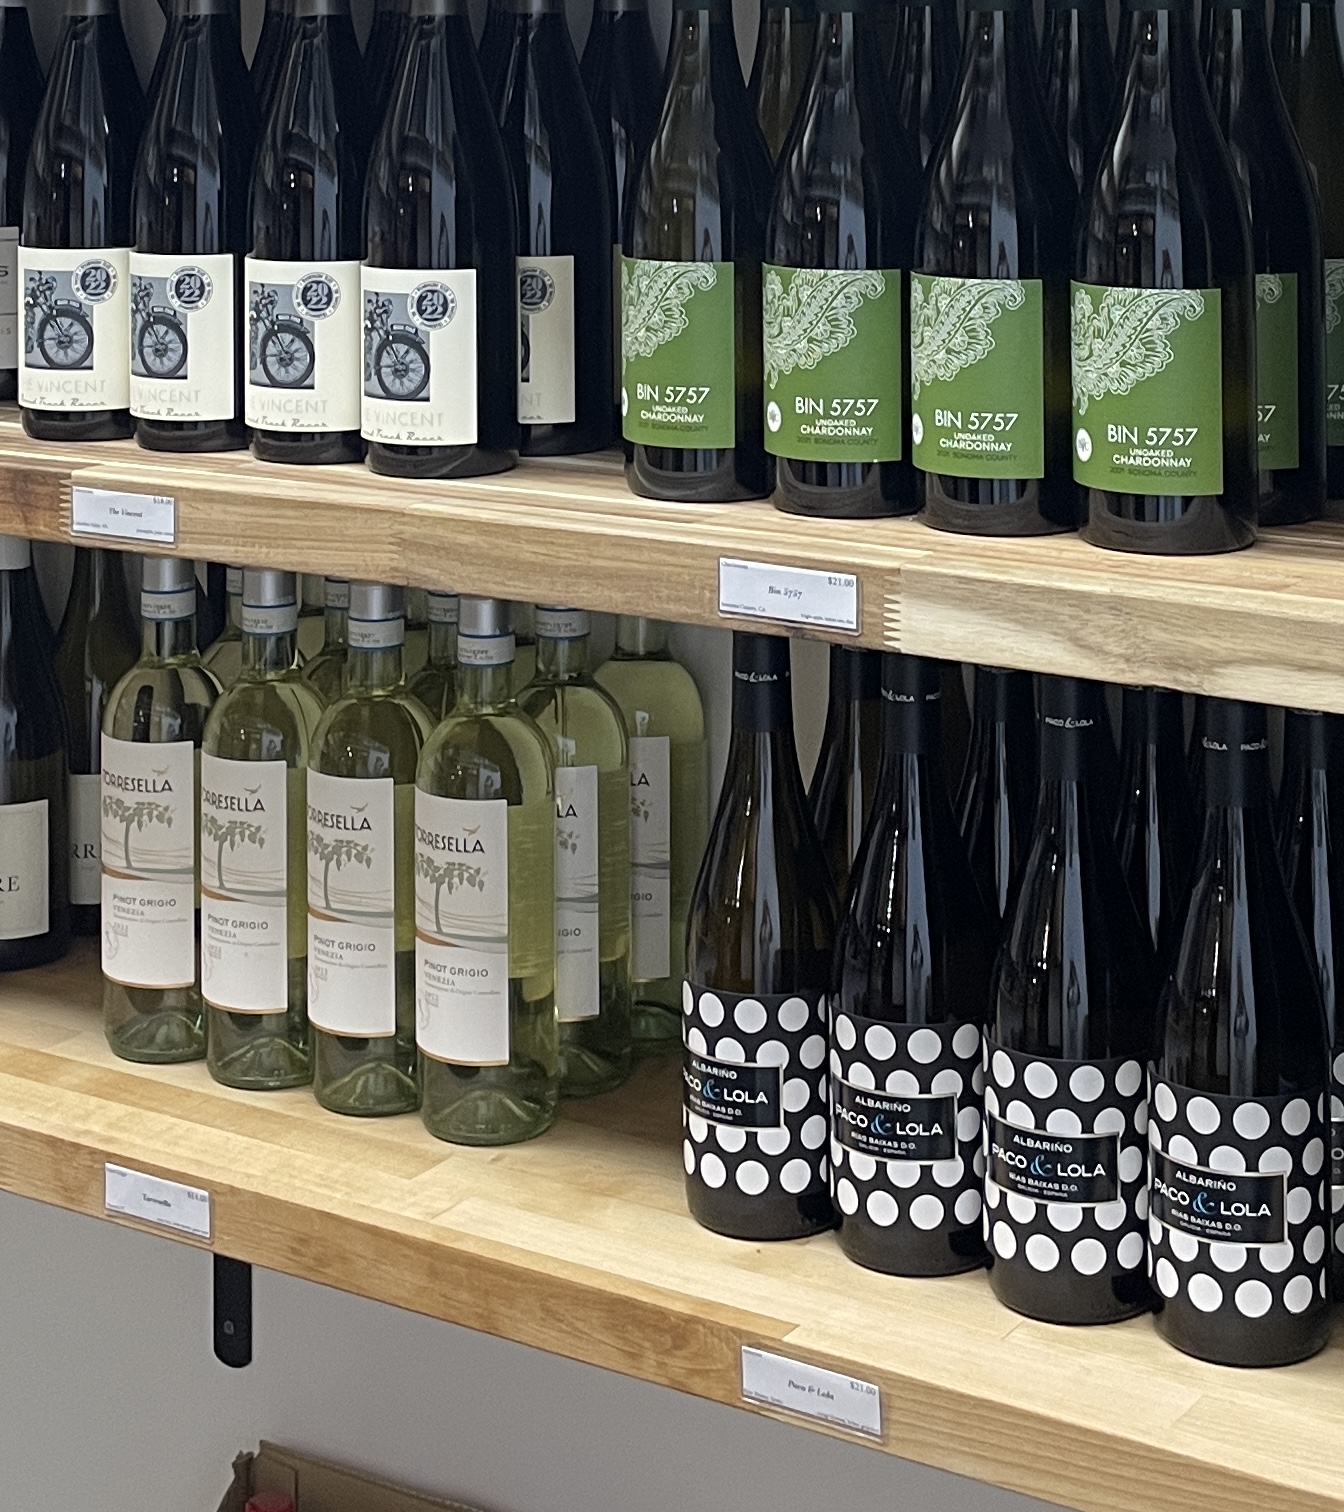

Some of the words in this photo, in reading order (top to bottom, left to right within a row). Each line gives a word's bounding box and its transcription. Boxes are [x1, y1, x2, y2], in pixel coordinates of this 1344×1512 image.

[637, 384, 659, 401] BIN
[665, 387, 709, 404] 5757
[795, 397, 824, 415] BIN
[831, 399, 879, 416] 5757
[641, 412, 704, 423] CHARDONNAY
[935, 410, 962, 428] BIN
[969, 413, 1018, 430] 5757
[801, 425, 873, 436] CHARDONNAY
[1108, 424, 1138, 445] BIN
[1146, 428, 1198, 446] 5757
[940, 439, 1012, 451] CHARDONNAY
[1113, 455, 1192, 468] CHARDONNAY
[314, 935, 337, 948] PINOT
[340, 941, 376, 952] GRIGIO
[424, 959, 450, 972] PINOT
[452, 966, 489, 978] GRIGIO
[692, 1059, 737, 1079] ALBARIÑO
[855, 1095, 911, 1113] ALBARIÑO
[836, 1103, 868, 1127] PACO
[871, 1114, 892, 1134] &
[896, 1122, 943, 1136] LOLA
[1013, 1135, 1072, 1153] ALBARIÑO
[992, 1143, 1028, 1169] PACO
[1030, 1155, 1053, 1176] &
[1057, 1163, 1106, 1178] LOLA
[1175, 1170, 1236, 1192] ALBARIÑO
[1155, 1177, 1190, 1207] PACO
[1192, 1191, 1215, 1214] &
[1220, 1202, 1271, 1217] LOLA
